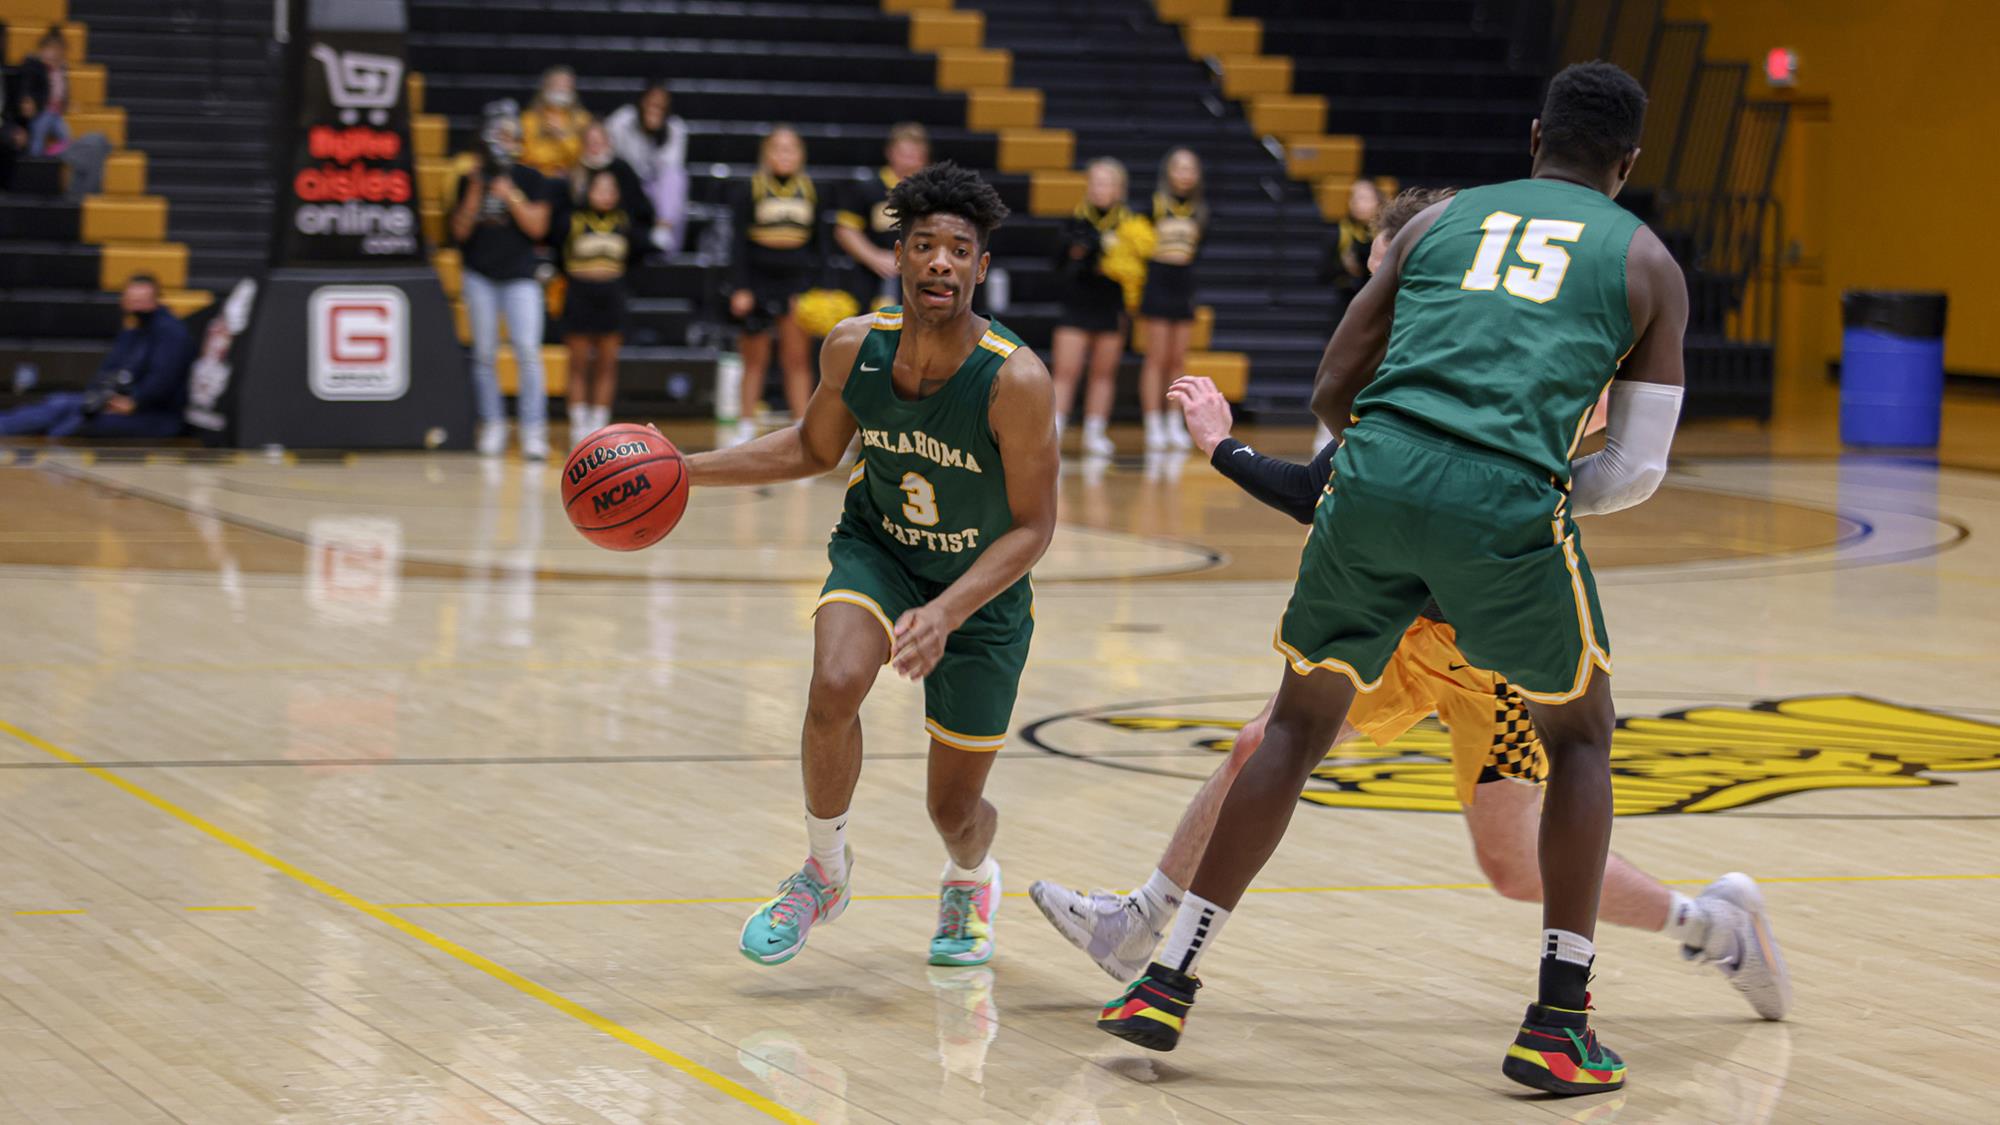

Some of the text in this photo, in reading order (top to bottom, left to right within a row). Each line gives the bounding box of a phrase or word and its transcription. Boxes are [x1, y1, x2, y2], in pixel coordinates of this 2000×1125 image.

[294, 162, 411, 202] aisles
[295, 199, 414, 235] online
[1460, 210, 1586, 304] 15
[567, 441, 650, 486] Wilson
[592, 473, 651, 514] NCAA
[899, 471, 940, 527] 3
